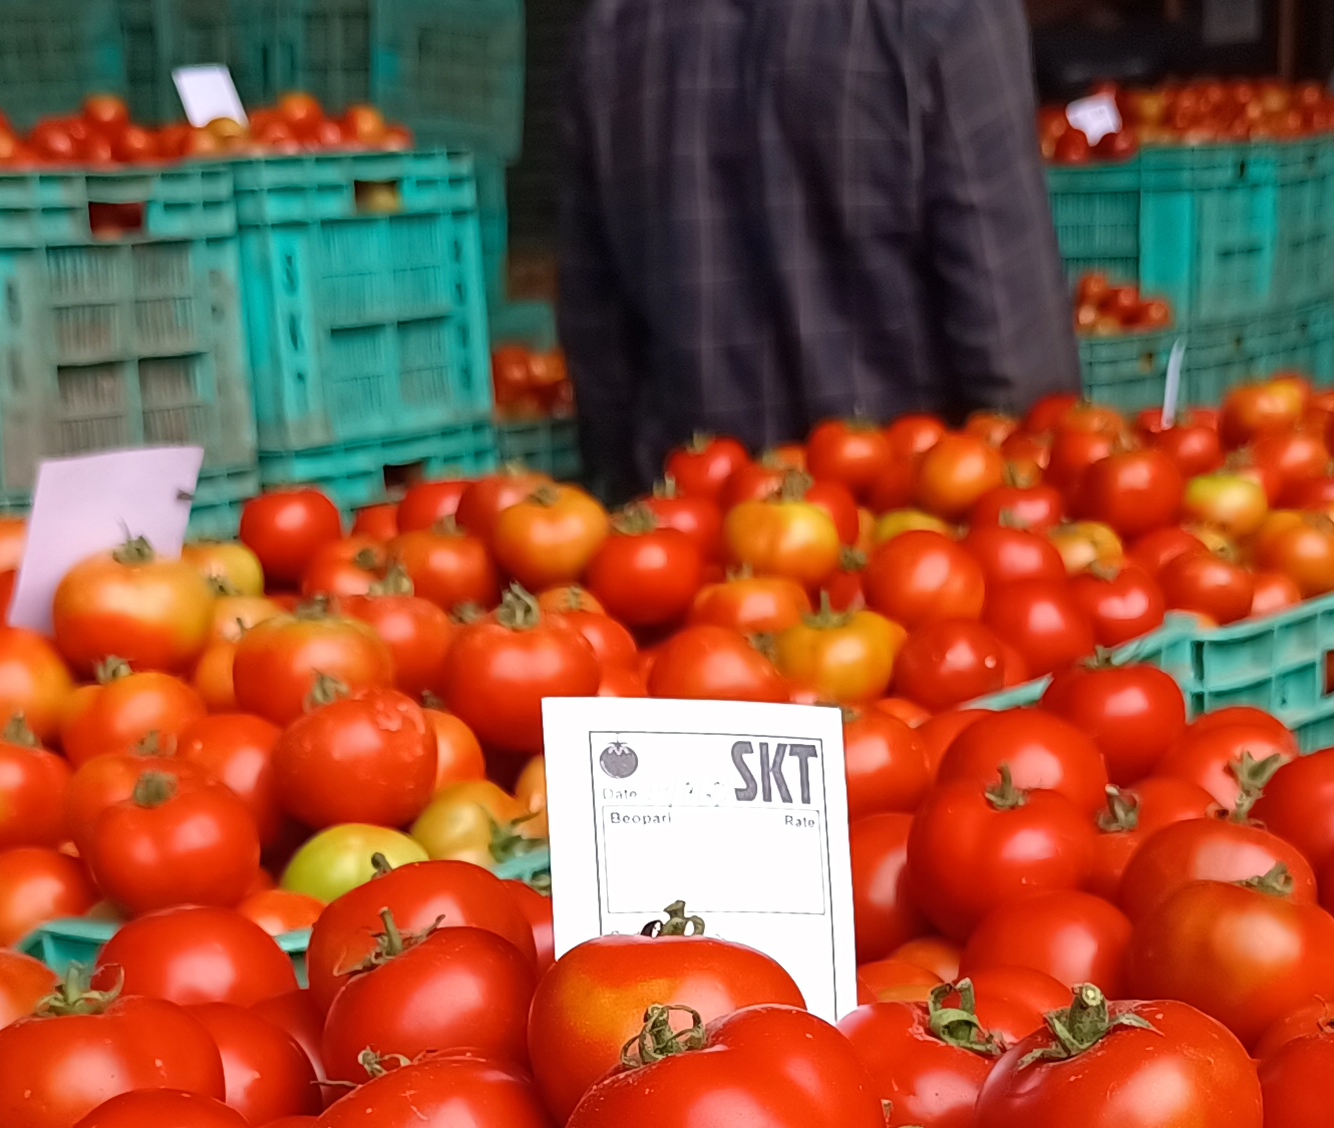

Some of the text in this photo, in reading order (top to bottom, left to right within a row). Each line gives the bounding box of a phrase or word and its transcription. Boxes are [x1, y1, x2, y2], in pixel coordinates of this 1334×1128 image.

[730, 740, 818, 805] SKT
[602, 787, 638, 800] Date
[610, 811, 816, 828] Beopari Rate
